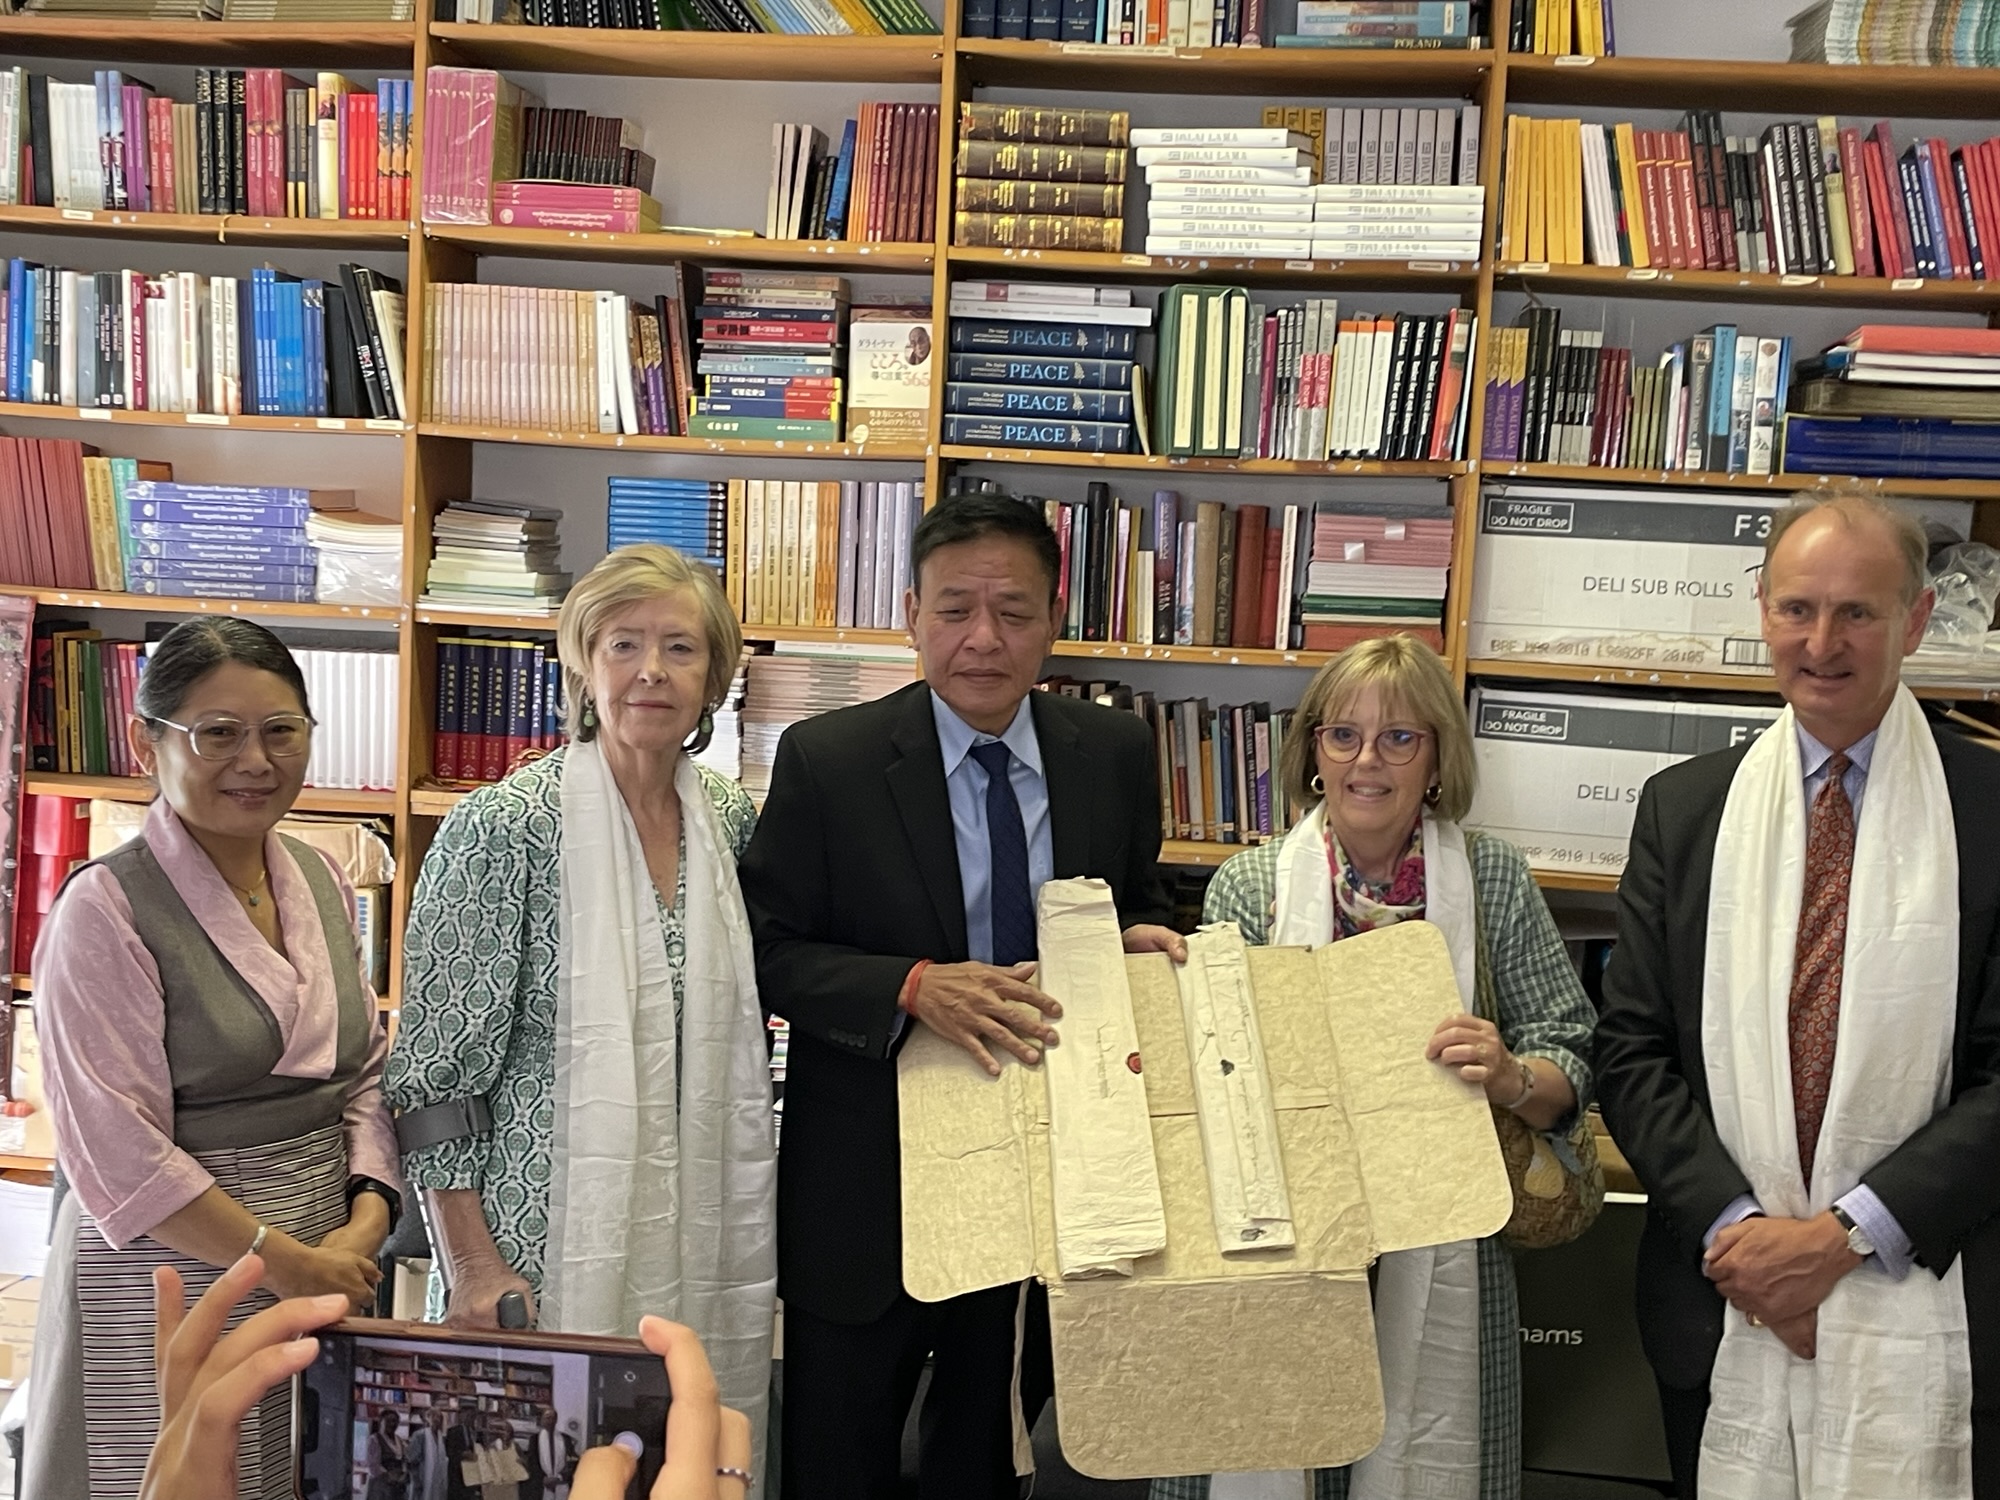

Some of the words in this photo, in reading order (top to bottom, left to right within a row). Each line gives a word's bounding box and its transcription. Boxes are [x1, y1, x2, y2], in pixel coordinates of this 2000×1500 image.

[1394, 38, 1442, 48] POLAND
[1175, 132, 1205, 142] DALAI
[1208, 133, 1239, 143] LAMA
[1183, 151, 1213, 160] DALAI
[1217, 151, 1247, 161] LAMA
[1194, 169, 1225, 179] DALAI
[1228, 170, 1260, 180] LAMA
[1327, 155, 1339, 183] DALA
[1345, 156, 1356, 183] DALA
[1365, 156, 1376, 182] DALA
[1382, 156, 1394, 183] DALA
[1403, 156, 1413, 183] DALA
[1421, 156, 1431, 184] DALA
[1438, 156, 1450, 184] DALA
[1234, 188, 1266, 198] LAMA
[1401, 189, 1432, 199] LAMA
[1230, 206, 1262, 215] LAMA
[1399, 207, 1432, 217] LAMA
[1232, 224, 1264, 233] LAMA
[1398, 225, 1430, 236] LAMA
[1229, 241, 1260, 250] LAMA
[1395, 244, 1427, 253] LAMA
[1012, 329, 1073, 347] PEACE
[1009, 363, 1070, 381] PEACE
[1303, 355, 1313, 381] duchy
[1319, 354, 1330, 381] duchy
[1737, 350, 1753, 393] Ireland
[902, 371, 931, 387] 365
[1006, 393, 1068, 411] PEACE
[1510, 396, 1519, 423] DALAI
[1004, 425, 1066, 443] PEACE
[1507, 423, 1517, 449] LAMA
[1507, 504, 1552, 515] FRAGILE
[1491, 515, 1507, 526] DO
[1509, 517, 1536, 527] NOT
[1536, 517, 1568, 528] DROP
[1583, 576, 1625, 593] DELI
[1631, 578, 1668, 595] SUB
[1674, 580, 1733, 598] ROLLS
[1556, 643, 1589, 655] 2010
[1502, 709, 1547, 722] FRAGILE
[1485, 720, 1502, 731] DO
[1504, 722, 1530, 733] NOT
[1530, 724, 1563, 735] DROP
[1577, 784, 1619, 801] DELI
[1549, 848, 1583, 862] 2010
